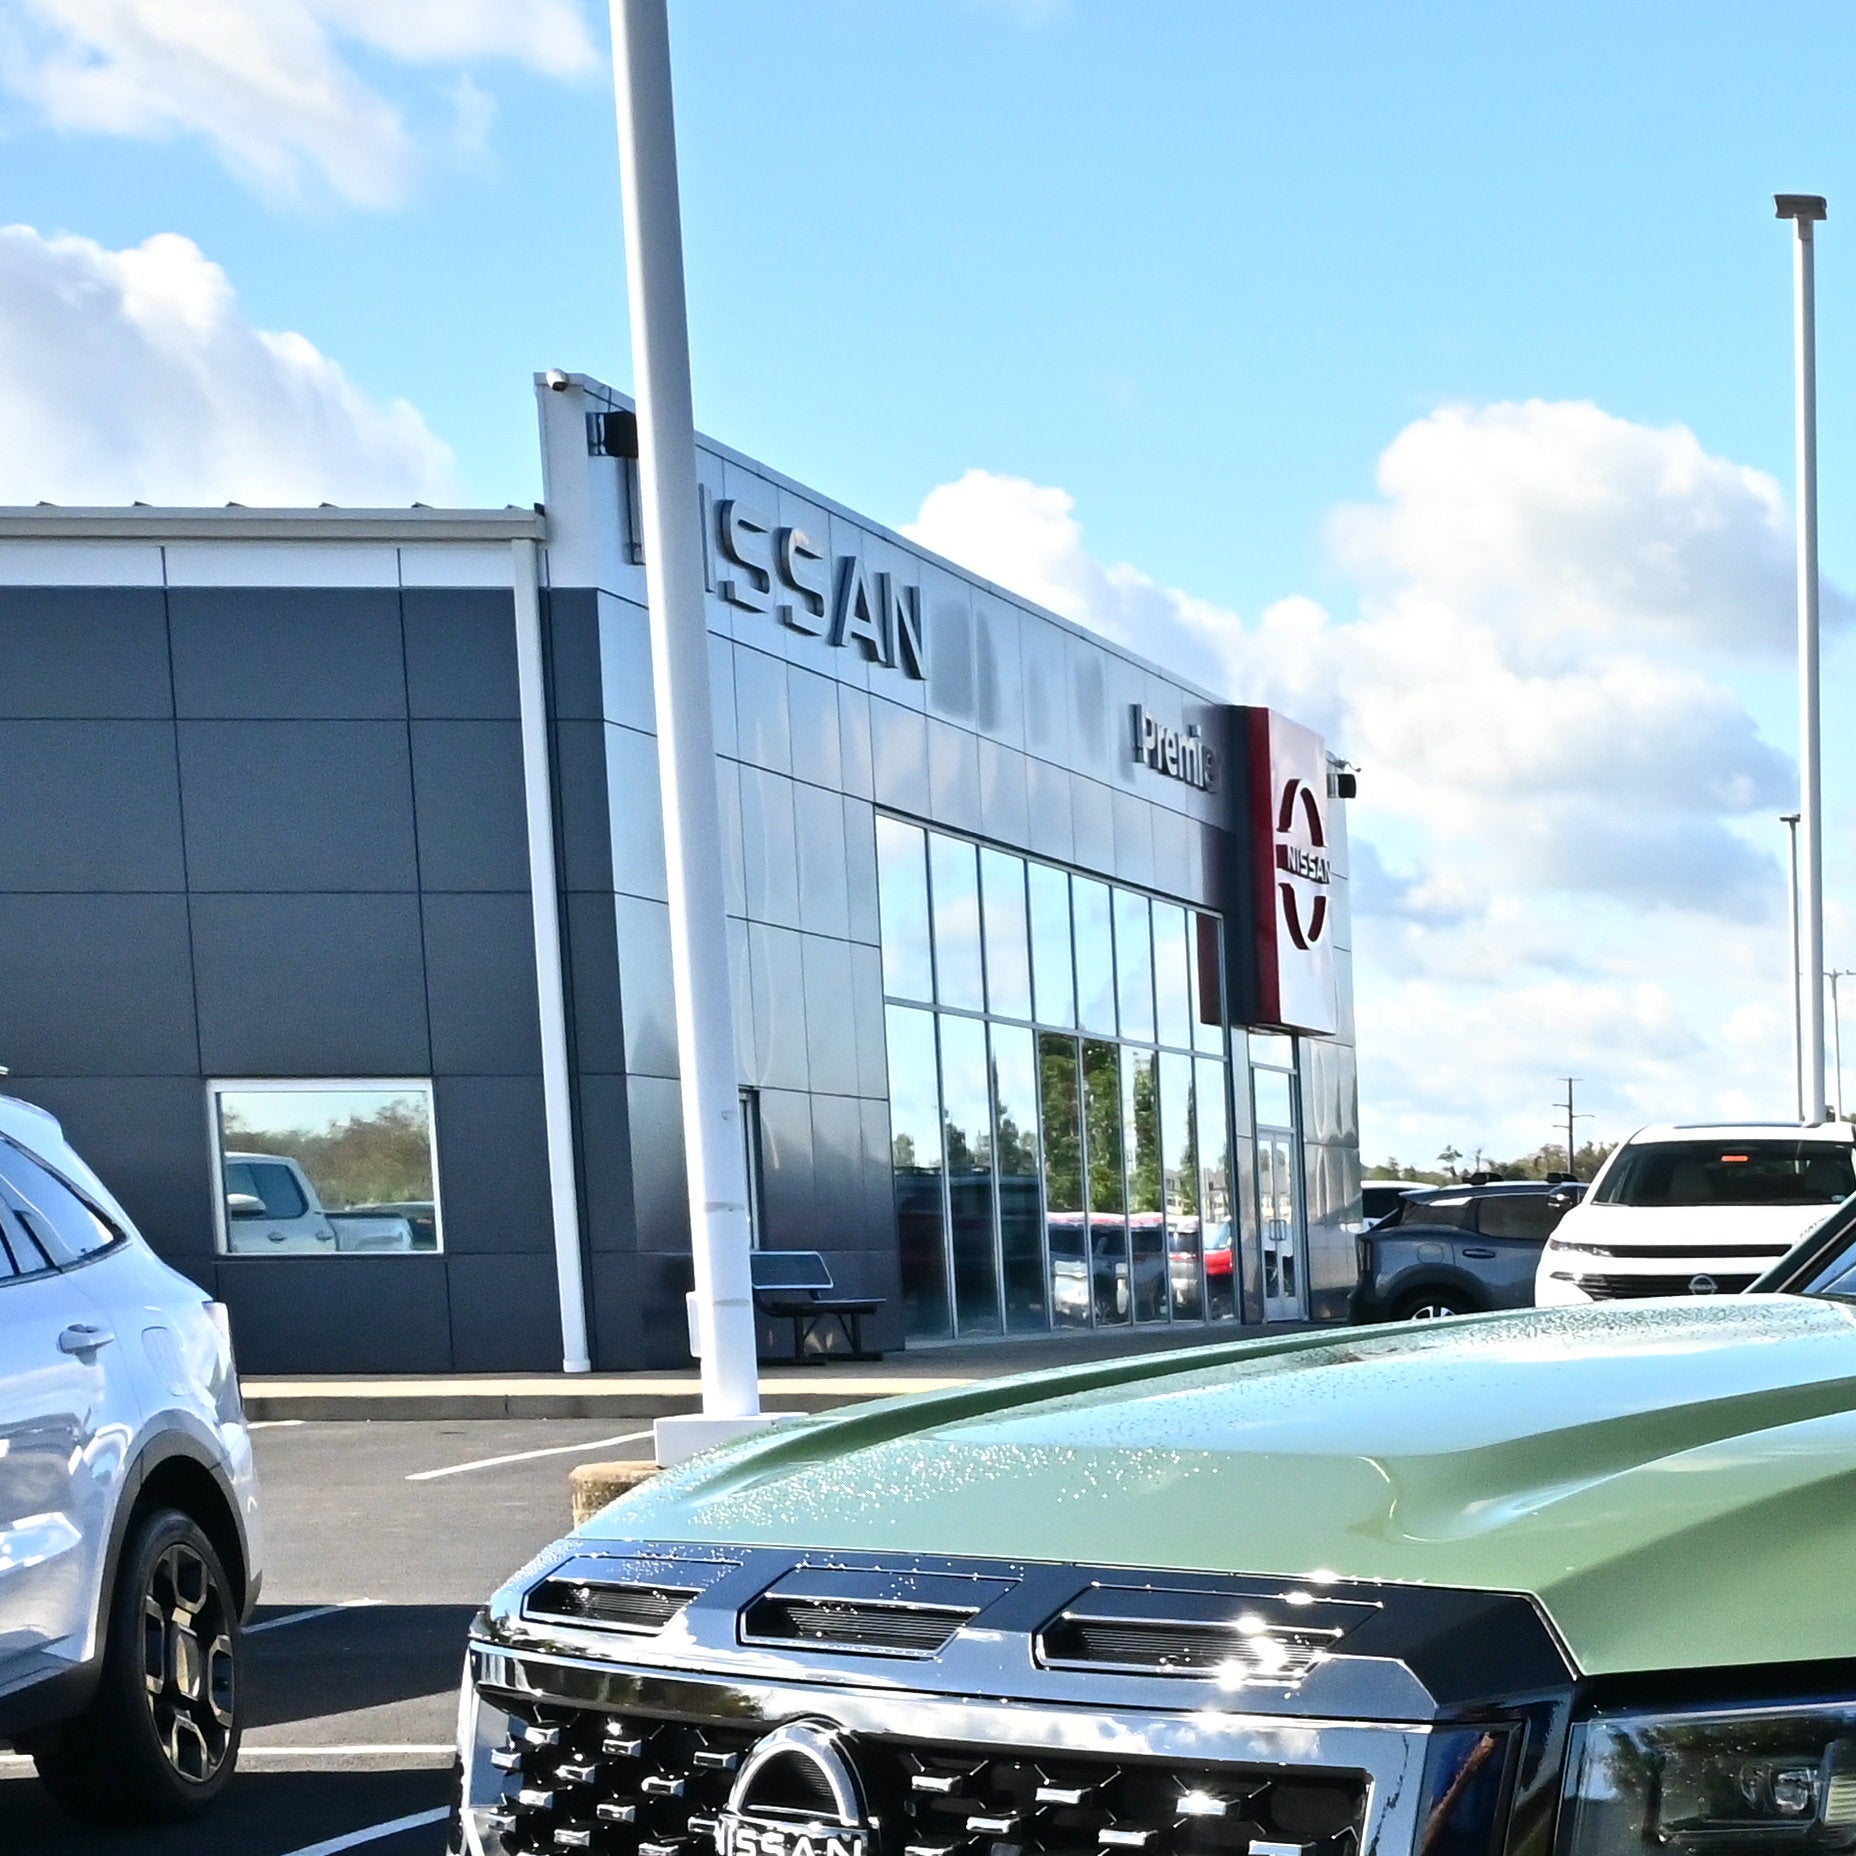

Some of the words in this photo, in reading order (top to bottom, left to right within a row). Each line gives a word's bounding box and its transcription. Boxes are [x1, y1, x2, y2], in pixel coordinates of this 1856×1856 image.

[626, 458, 928, 680] ISSAN
[1130, 704, 1216, 794] Premie
[1287, 843, 1332, 886] NISSAN
